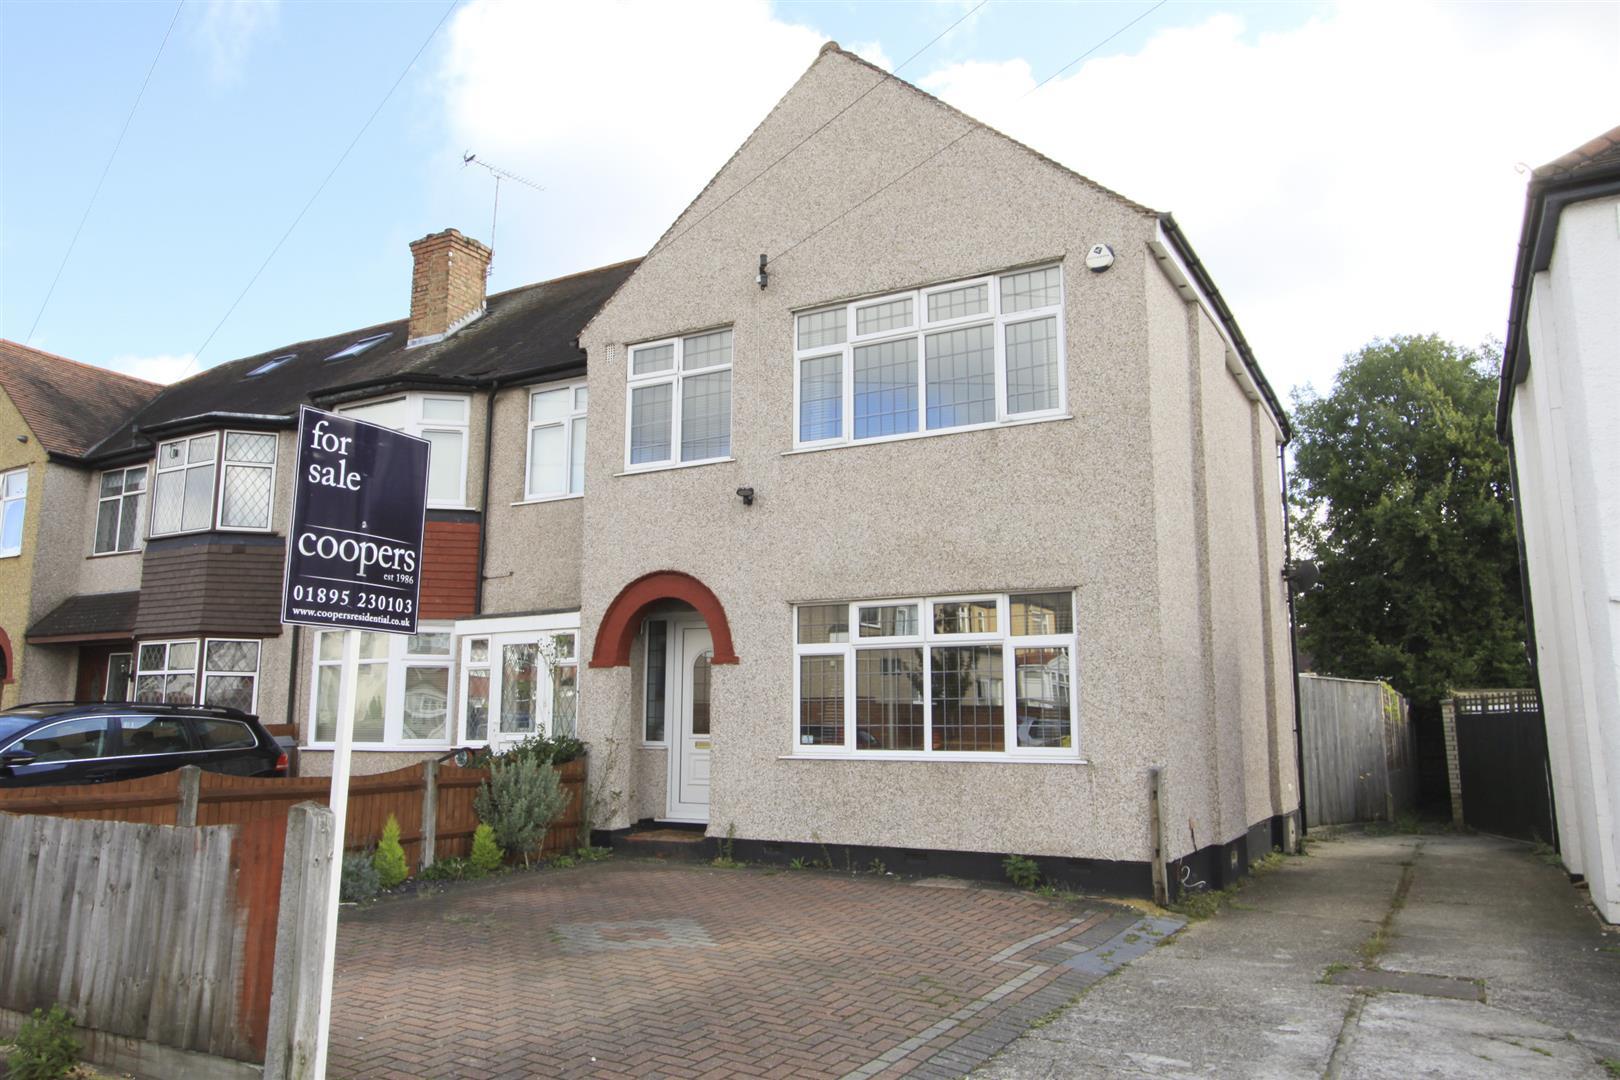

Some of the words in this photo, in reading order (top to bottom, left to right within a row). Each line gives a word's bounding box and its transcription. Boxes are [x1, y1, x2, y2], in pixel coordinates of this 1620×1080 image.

[310, 420, 352, 456] for
[308, 458, 361, 491] sale
[298, 532, 415, 577] coopers
[383, 573, 394, 582] est
[396, 573, 414, 584] 1986
[293, 584, 350, 606] 01895
[357, 592, 413, 614] 230103
[292, 607, 410, 627] www.coopersresidential.co.uk
